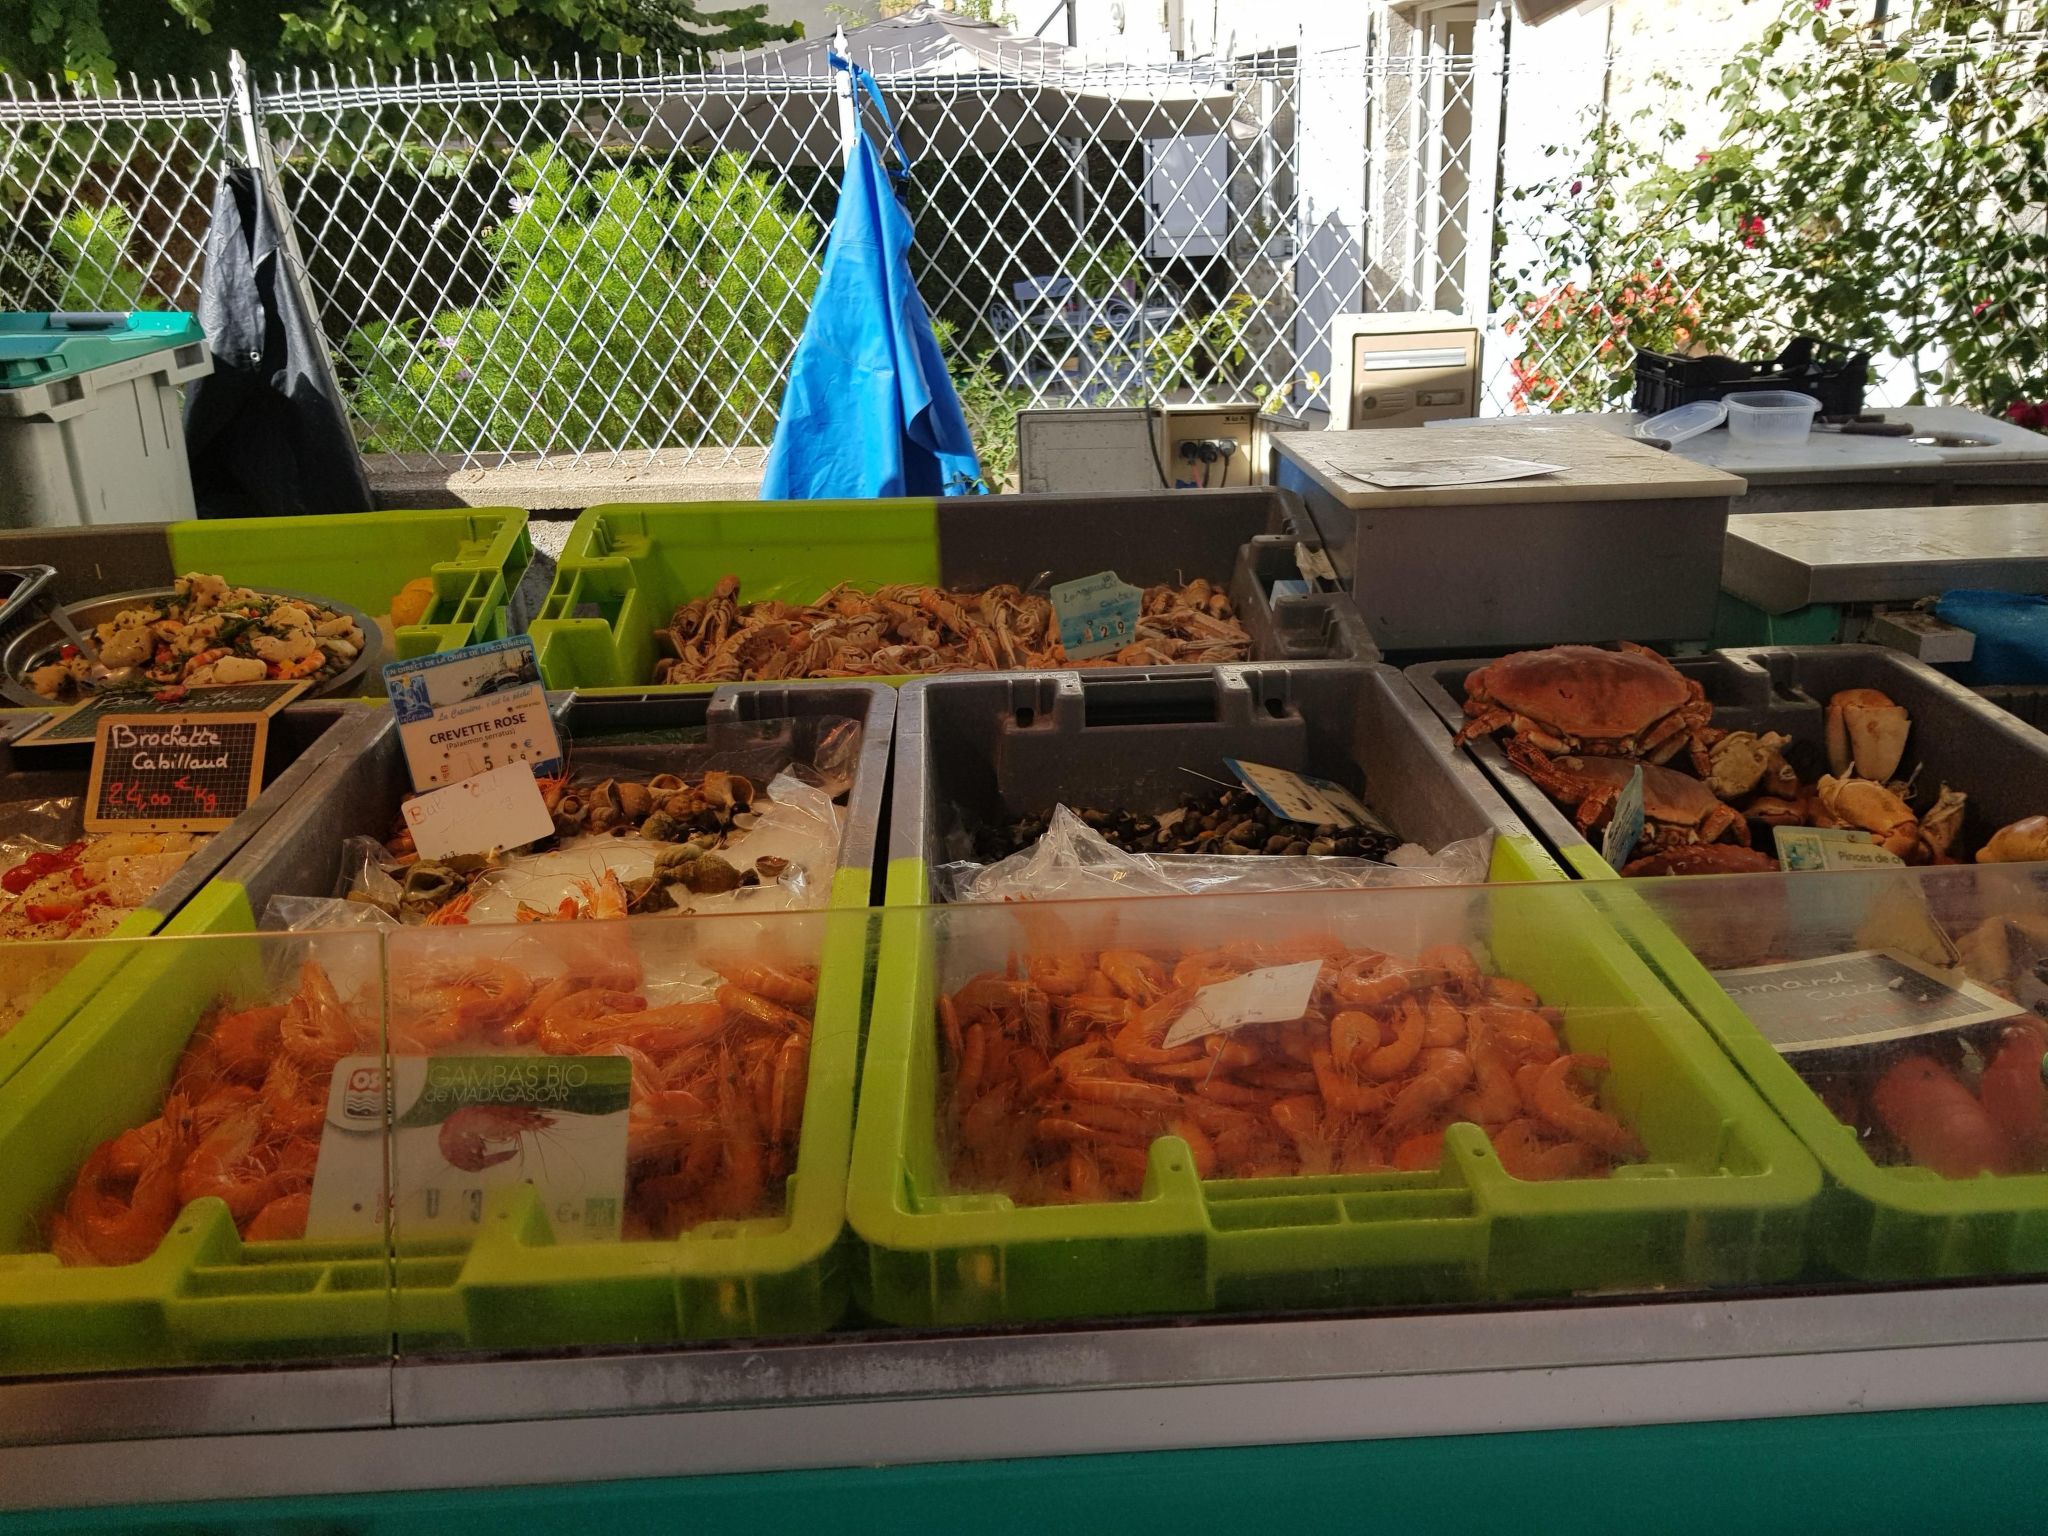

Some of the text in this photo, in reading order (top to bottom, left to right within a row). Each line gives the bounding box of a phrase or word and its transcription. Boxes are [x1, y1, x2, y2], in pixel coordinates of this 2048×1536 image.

[398, 661, 423, 674] DIRECT
[425, 659, 437, 668] DE
[111, 724, 222, 750] Brochette
[429, 713, 528, 745] CREVETTE ROSE
[132, 752, 229, 770] Cabillaud
[1838, 851, 1873, 863] Pinces
[1875, 854, 1889, 864] de
[1723, 970, 1853, 997] omard
[429, 1063, 589, 1088] GAMBAS BIO
[424, 1086, 570, 1102] de MADAGASCAR
